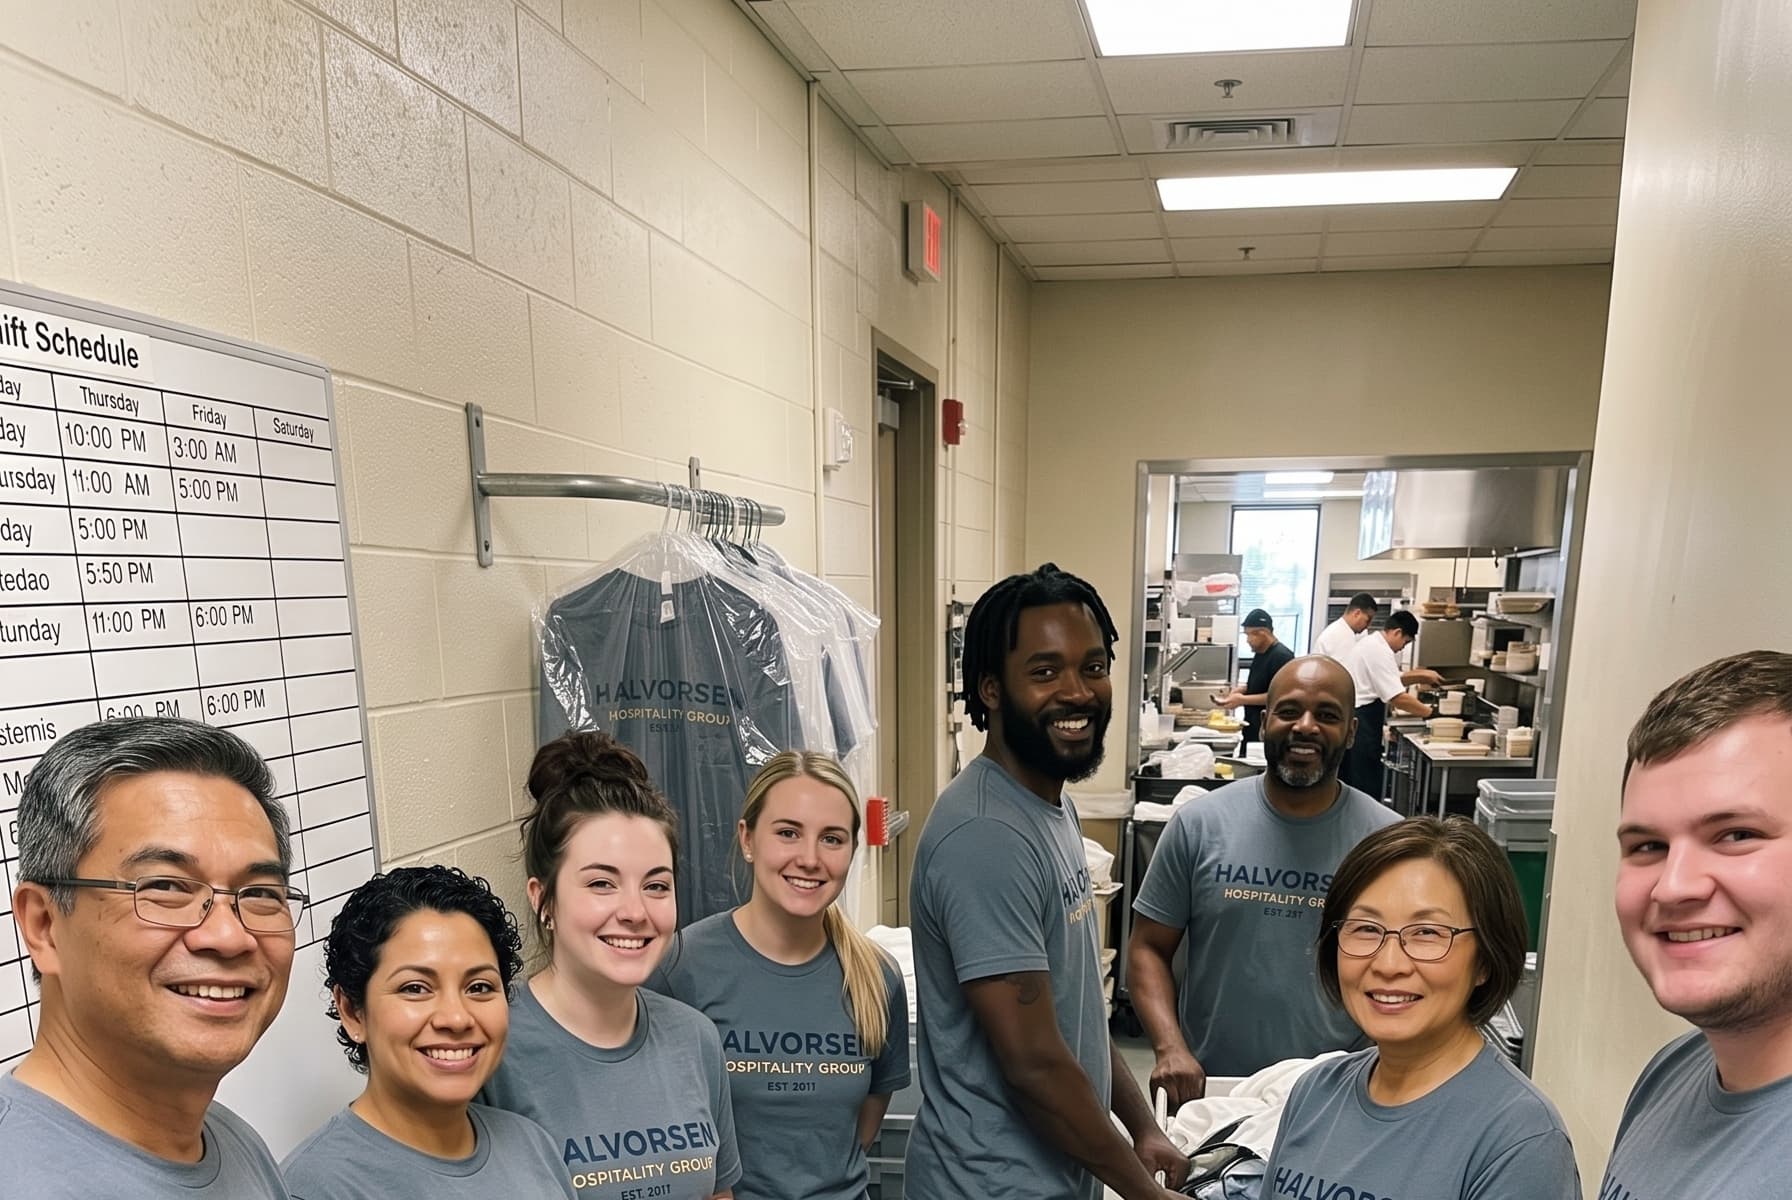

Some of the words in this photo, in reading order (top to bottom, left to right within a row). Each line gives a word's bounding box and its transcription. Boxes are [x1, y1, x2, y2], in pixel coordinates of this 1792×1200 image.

[35, 321, 139, 368] Schedule
[79, 386, 139, 417] Thursday
[192, 404, 227, 430] Friday
[65, 422, 112, 449] 10:00
[121, 428, 146, 452] PM
[273, 418, 314, 443] Saturday
[173, 436, 207, 460] 3:00
[215, 441, 237, 464] AM
[73, 469, 112, 494] 11:00
[124, 472, 150, 496] AM
[179, 477, 211, 500] 5:00
[216, 481, 238, 502] PM
[78, 517, 116, 540] 5:00
[122, 518, 148, 540] PM
[85, 562, 123, 584] 5:50
[128, 562, 153, 584] PM
[92, 610, 133, 634] 11:00
[141, 608, 166, 629] PM
[195, 606, 227, 627] 6:00
[232, 604, 254, 625] PM
[156, 699, 180, 718] PM
[207, 692, 239, 716] 6:00
[243, 688, 266, 710] PM
[1215, 863, 1334, 892] HALVORS
[1224, 888, 1305, 906] HOSPITALITY
[723, 1030, 864, 1056] ALVORSE
[726, 1061, 813, 1074] OSPITALITY
[818, 1062, 865, 1074] GROUP
[792, 1082, 816, 1092] 2011
[563, 1122, 717, 1166] ALVORSEN
[572, 1163, 665, 1189] OSPITALITY
[670, 1156, 713, 1174] GROUP
[648, 1184, 671, 1197] 2011
